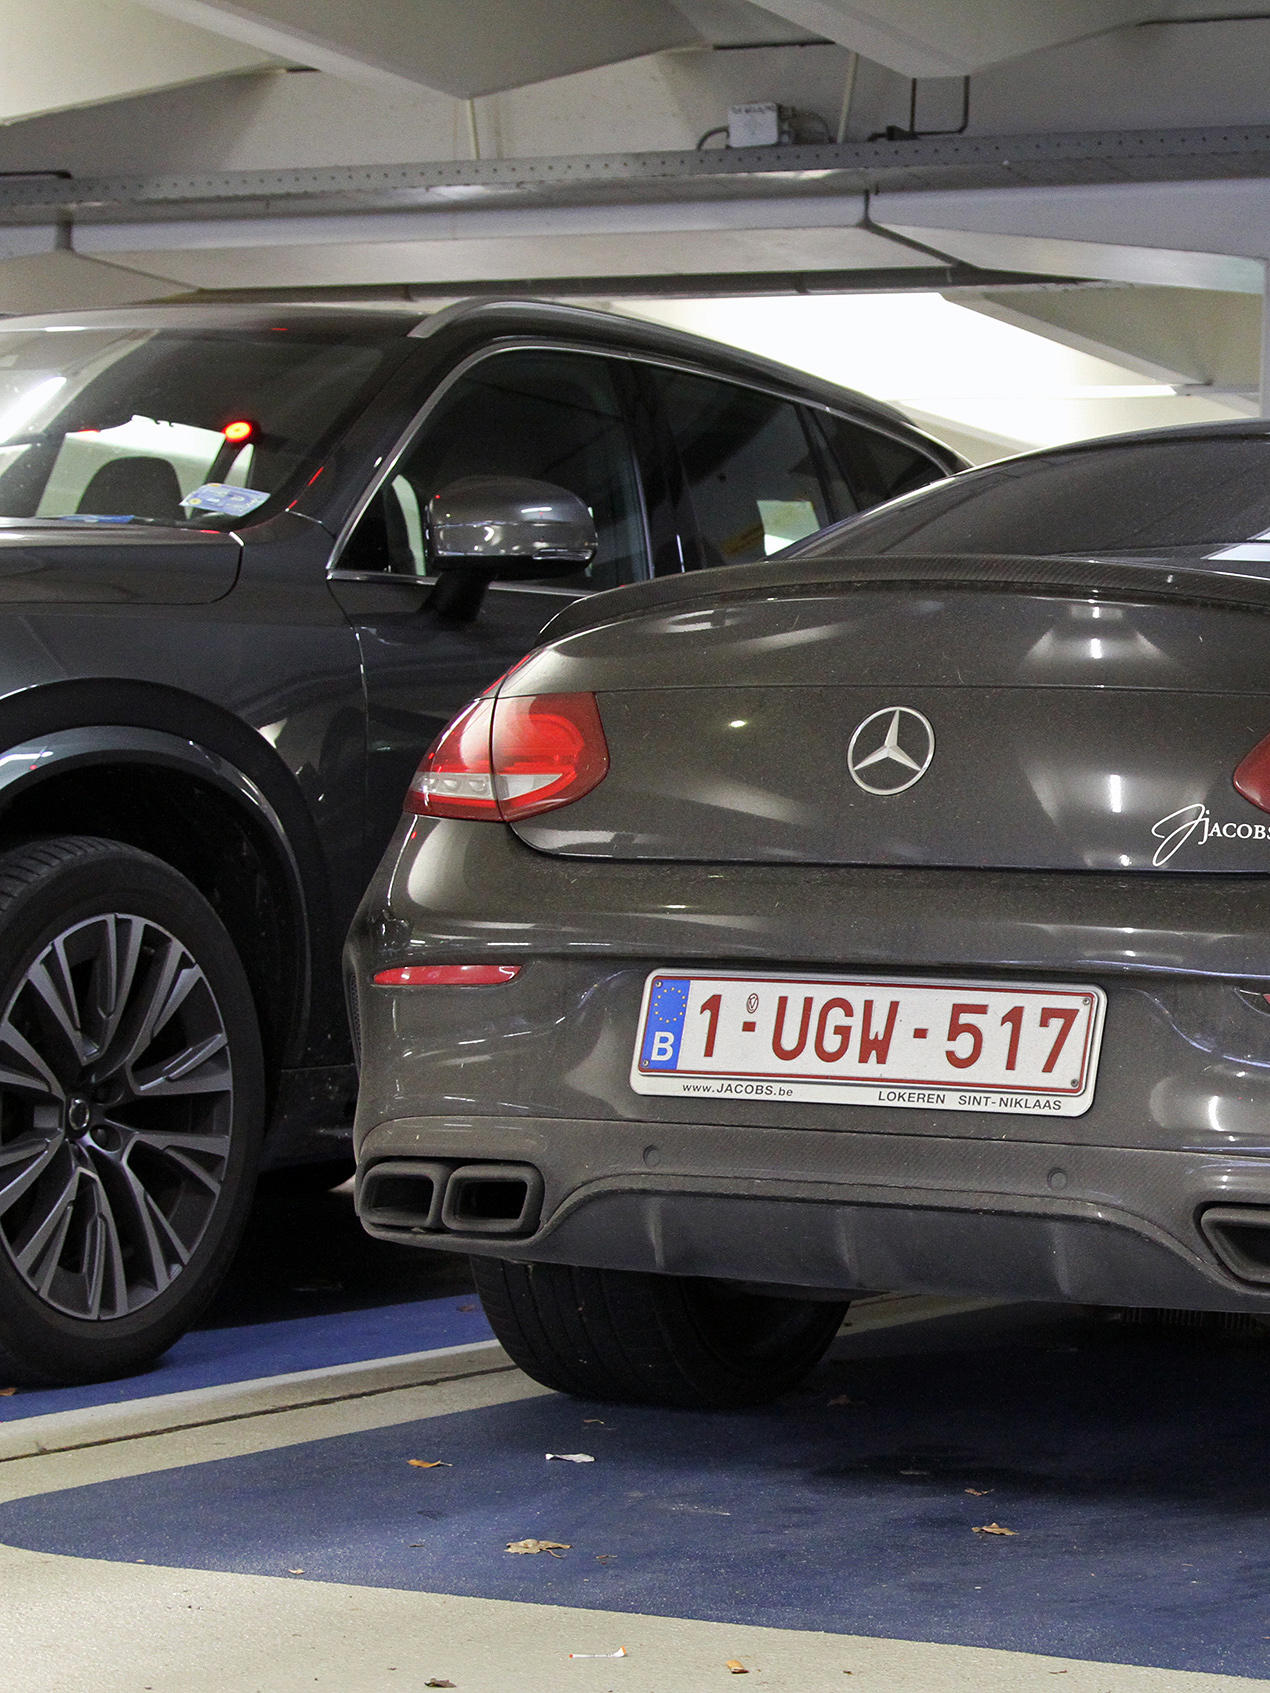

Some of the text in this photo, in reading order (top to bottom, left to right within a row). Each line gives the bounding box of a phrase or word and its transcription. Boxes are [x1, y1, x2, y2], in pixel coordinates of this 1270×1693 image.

[651, 1032, 674, 1061] B
[682, 1083, 793, 1096] www.JACOBS.be
[878, 1091, 1062, 1110] LOKEREN SINT-NIKLAAS
